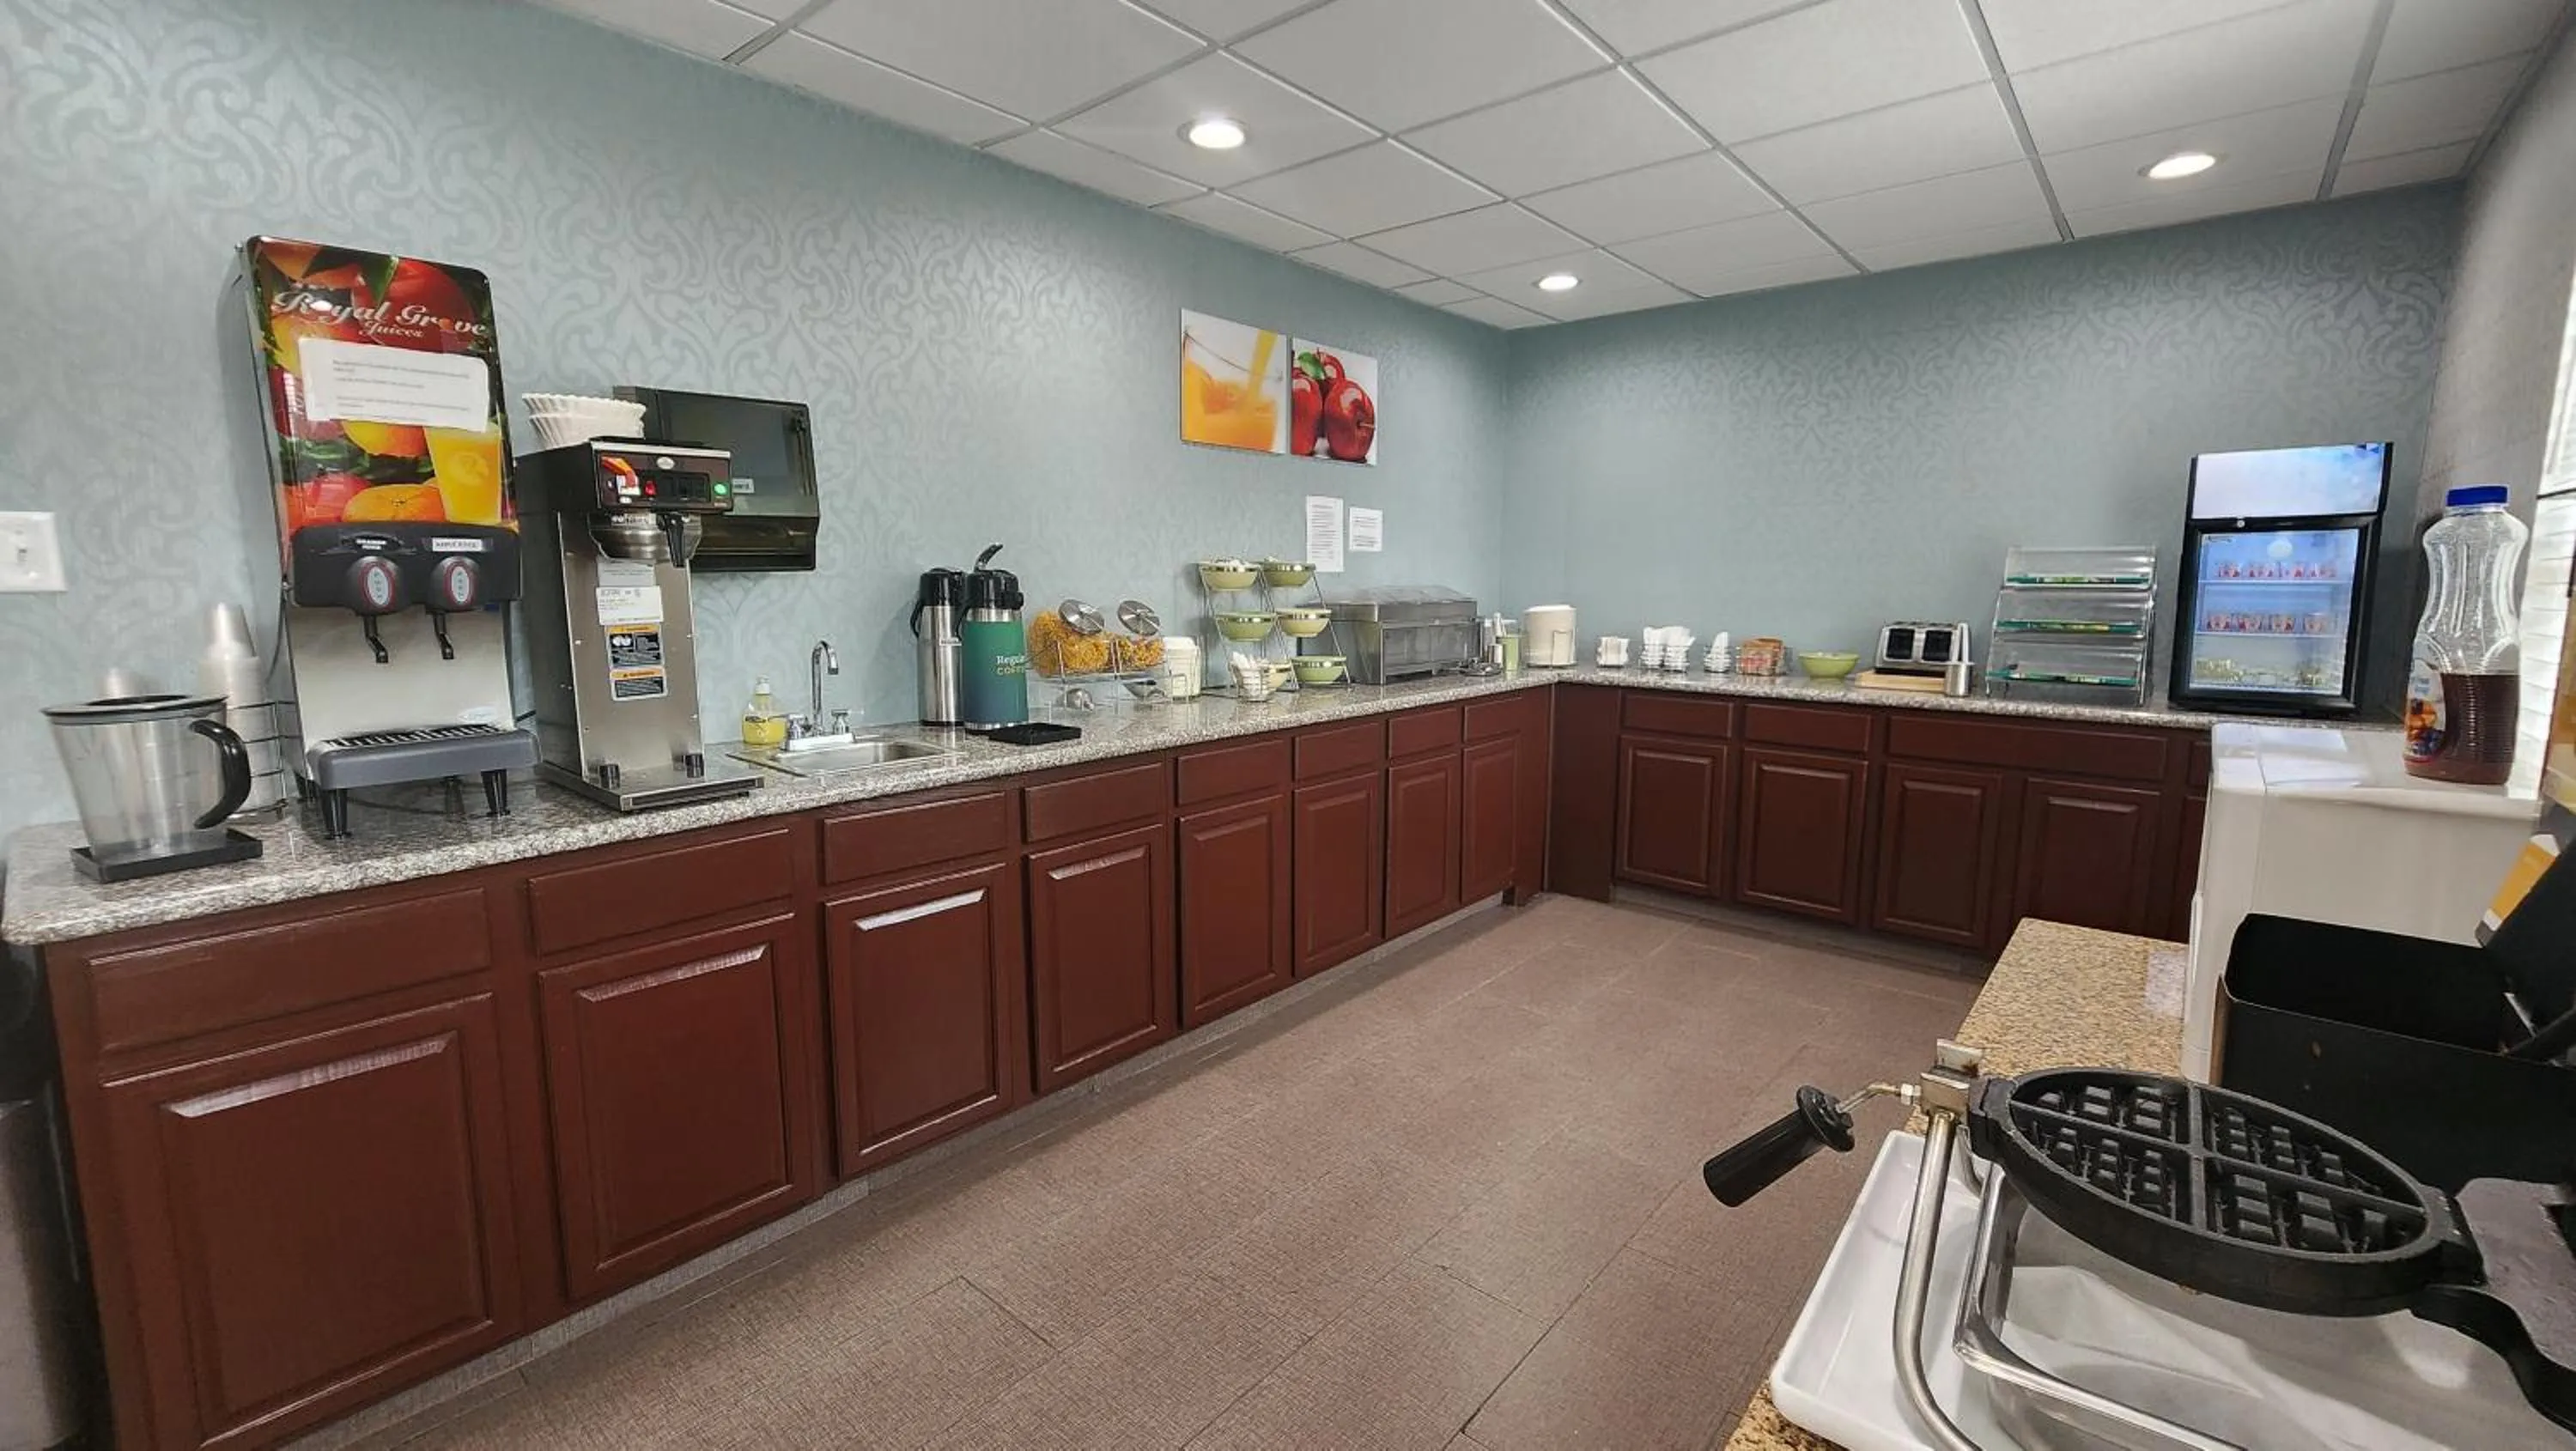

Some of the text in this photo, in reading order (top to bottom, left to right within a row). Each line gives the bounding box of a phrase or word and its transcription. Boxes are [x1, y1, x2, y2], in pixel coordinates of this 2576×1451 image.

[271, 291, 488, 336] Royal Grove
[358, 321, 425, 338] Juices
